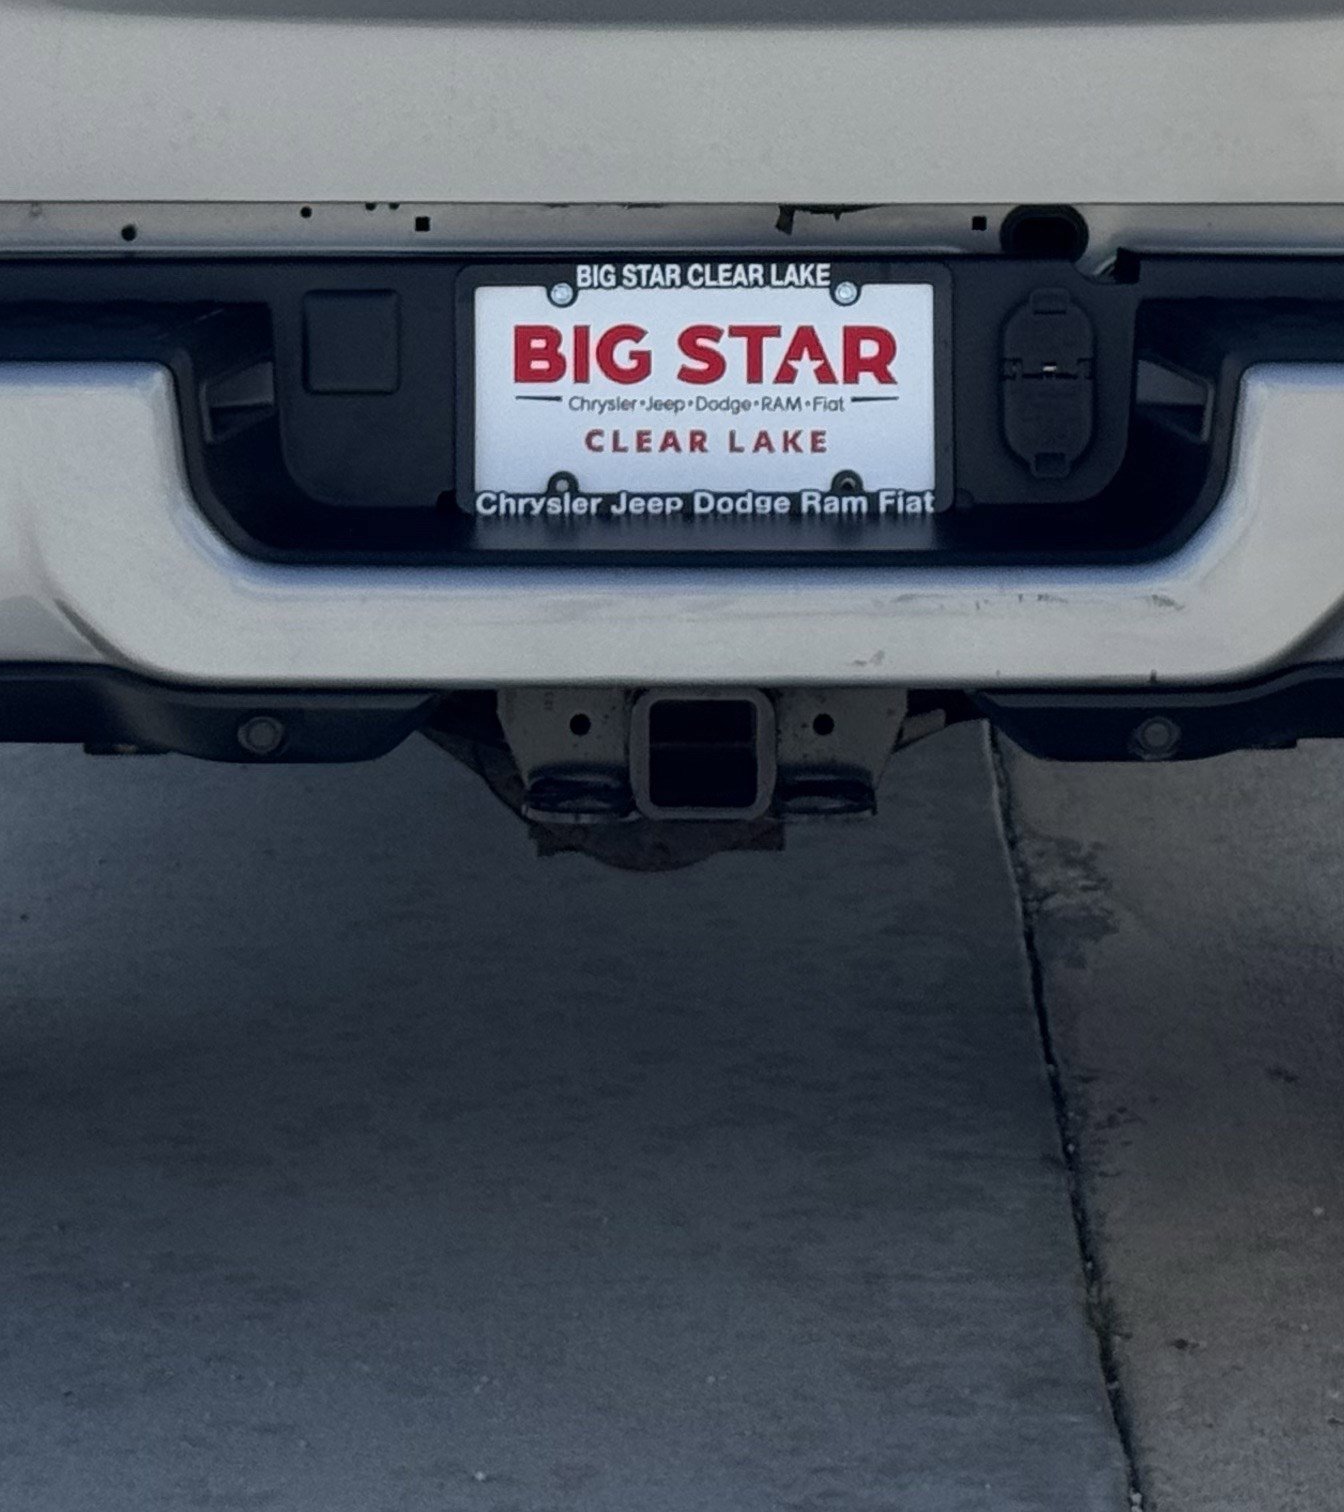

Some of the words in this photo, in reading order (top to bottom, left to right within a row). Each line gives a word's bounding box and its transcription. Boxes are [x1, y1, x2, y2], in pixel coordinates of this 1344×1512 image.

[576, 264, 616, 287] BIG
[622, 264, 681, 287] STAR
[687, 263, 765, 287] CLEAR
[770, 263, 831, 287] LAKE
[513, 324, 652, 384] BIG
[676, 324, 898, 385] STAR
[568, 395, 637, 415] Chrysler
[645, 396, 686, 413] Jeep
[695, 395, 752, 415] Dodge
[761, 396, 802, 410] RAM
[813, 395, 845, 412] Fiat
[584, 429, 709, 454] CLEAR
[728, 429, 828, 454] LAKE
[475, 491, 602, 515] Chrysler
[610, 491, 684, 515] Jeep
[693, 490, 791, 514] Dodge
[801, 490, 868, 514] Ram
[878, 490, 935, 514] Fiat
